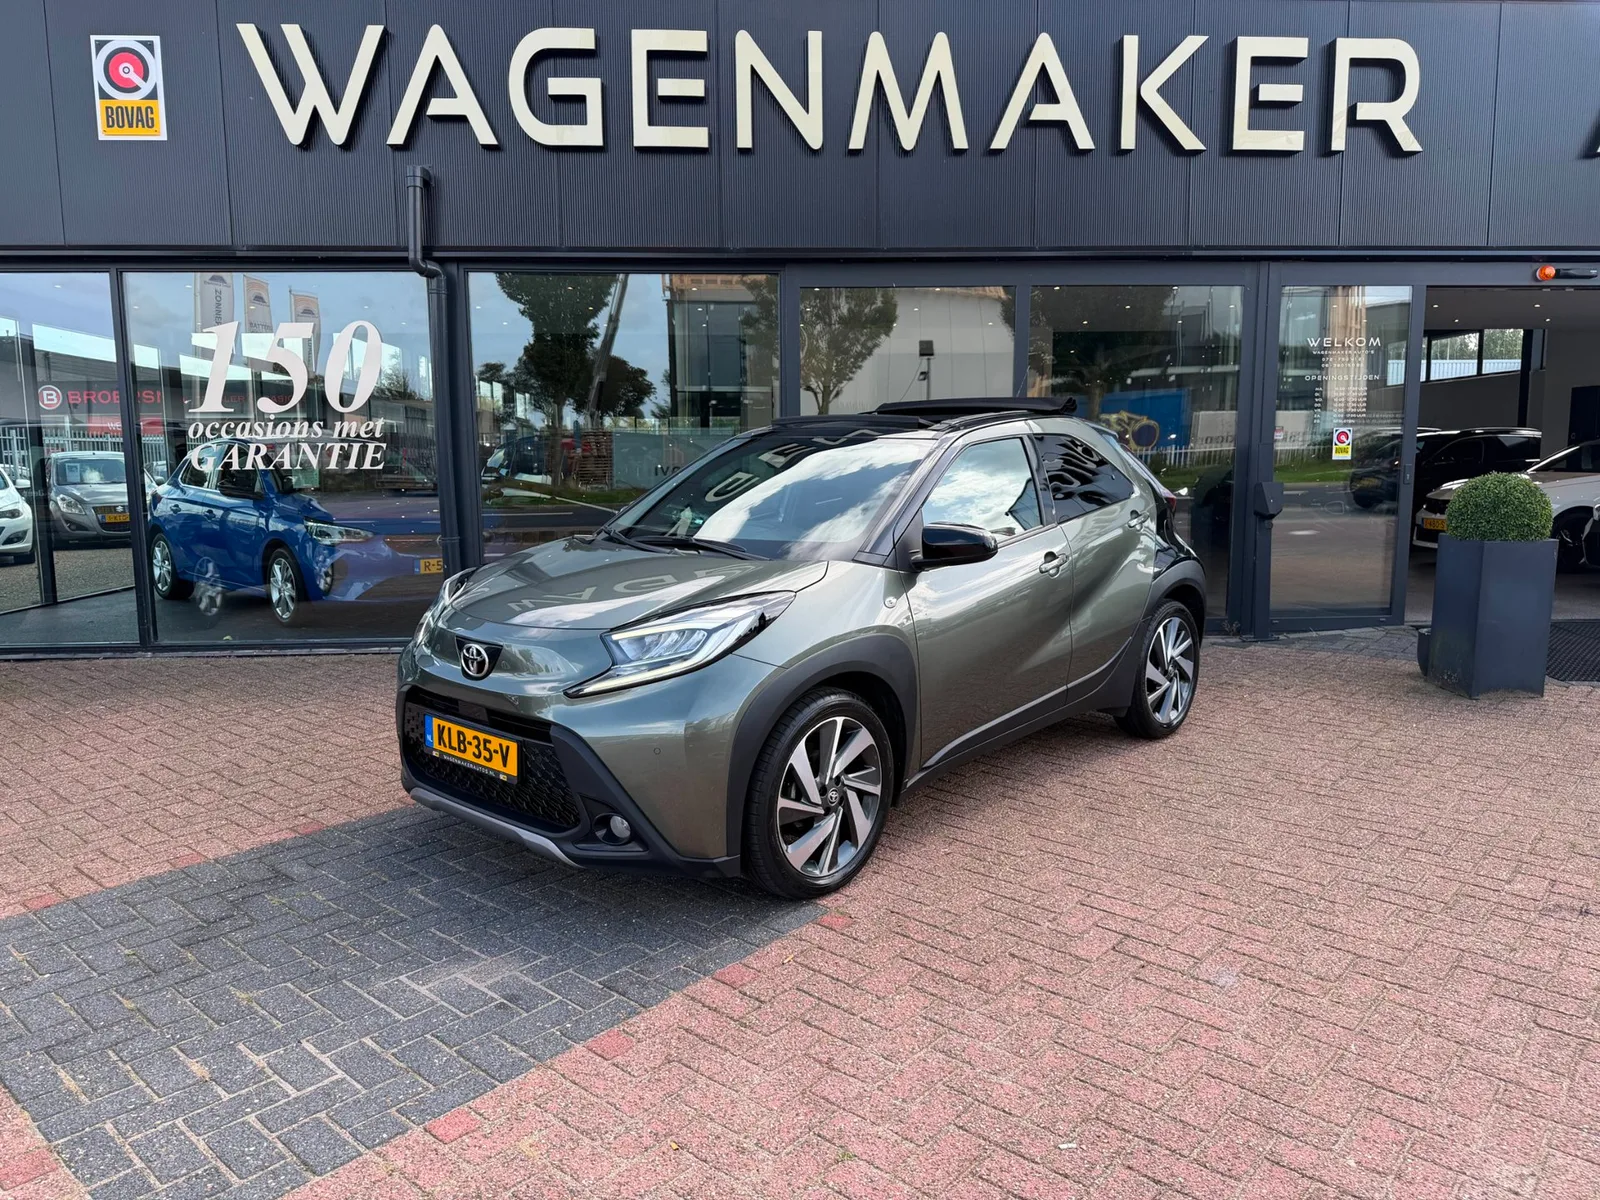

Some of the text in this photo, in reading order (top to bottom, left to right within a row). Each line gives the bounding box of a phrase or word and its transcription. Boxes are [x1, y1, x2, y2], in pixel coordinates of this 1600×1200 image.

[236, 22, 1423, 154] WAGENMAKER
[104, 105, 155, 129] BOVAG
[1306, 336, 1382, 348] WELKOM
[189, 320, 383, 413] 150
[188, 413, 384, 439] occasions met
[190, 441, 387, 471] GARANTIE
[437, 723, 510, 768] KLB-35-V
